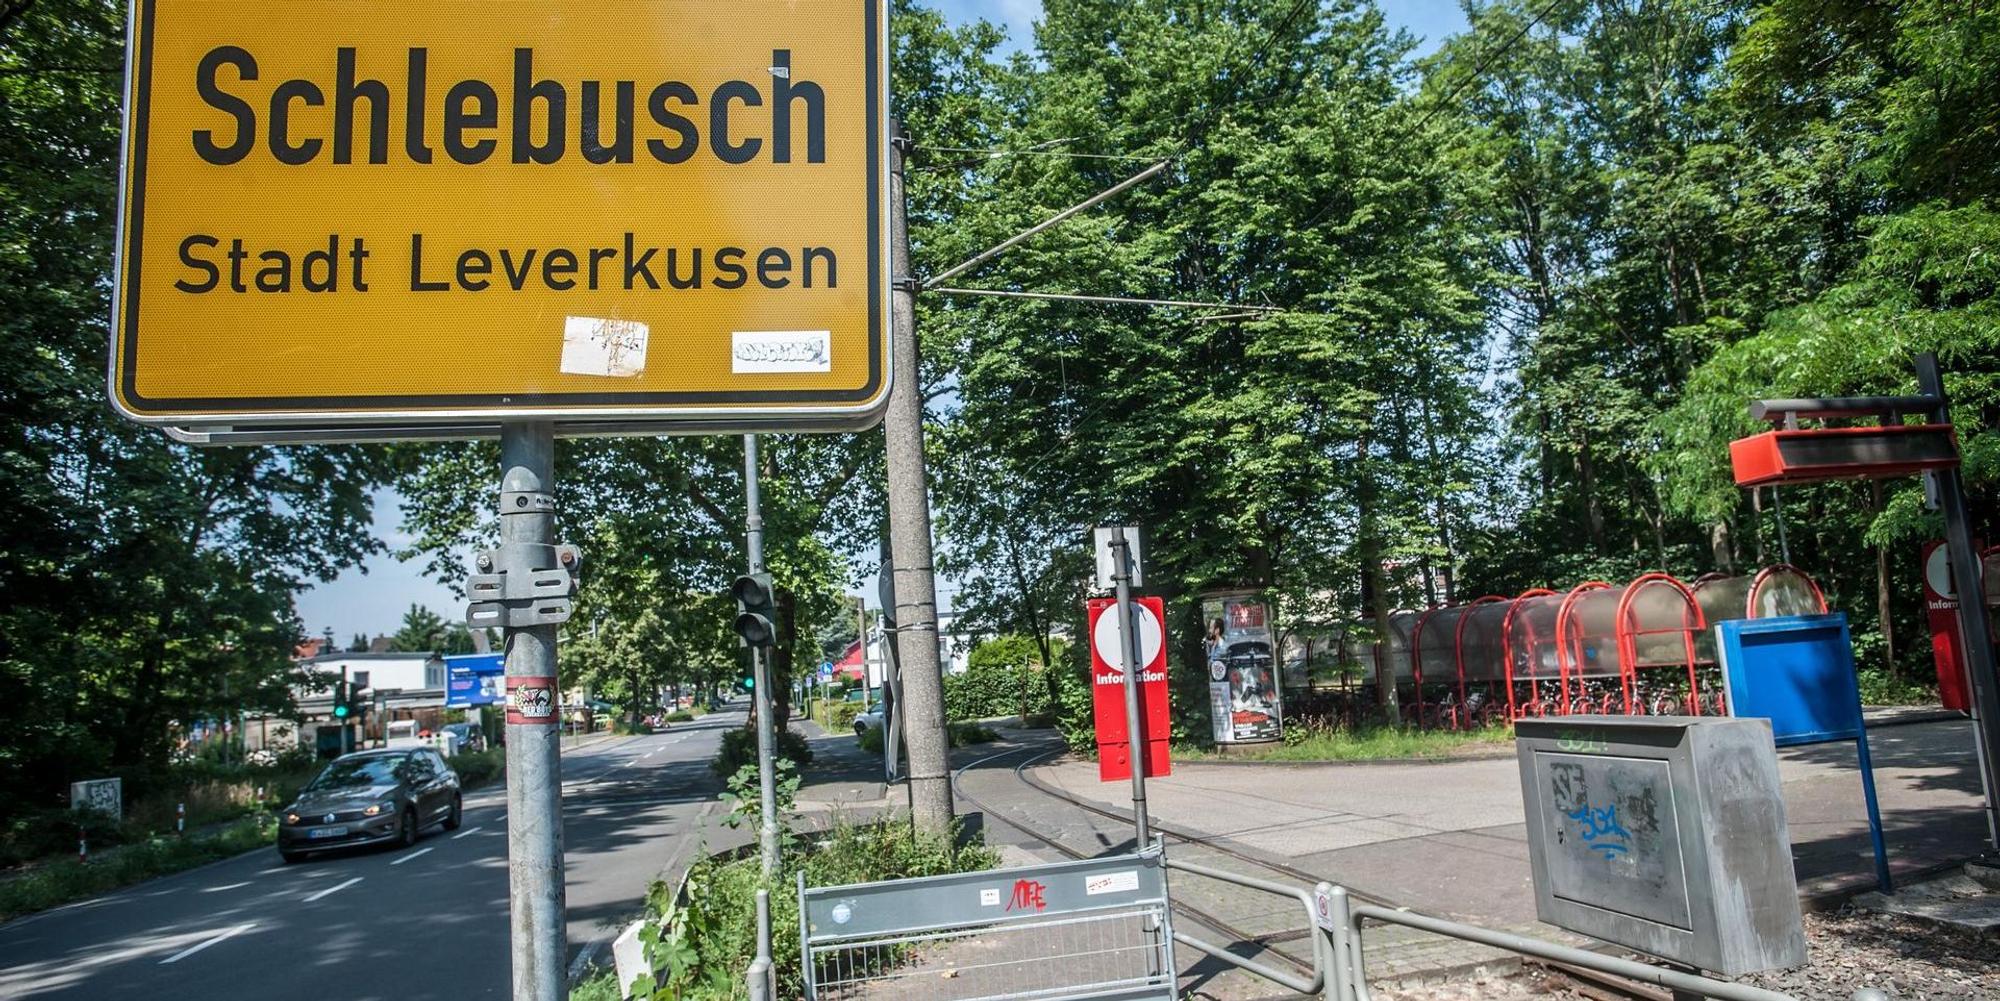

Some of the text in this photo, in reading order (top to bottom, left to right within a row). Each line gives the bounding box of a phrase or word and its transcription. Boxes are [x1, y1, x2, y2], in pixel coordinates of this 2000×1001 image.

[191, 45, 827, 167] Schlebusch
[173, 232, 838, 294] Stadt Leverkusen
[1927, 599, 1959, 610] Inform
[1096, 670, 1165, 684] Inforation
